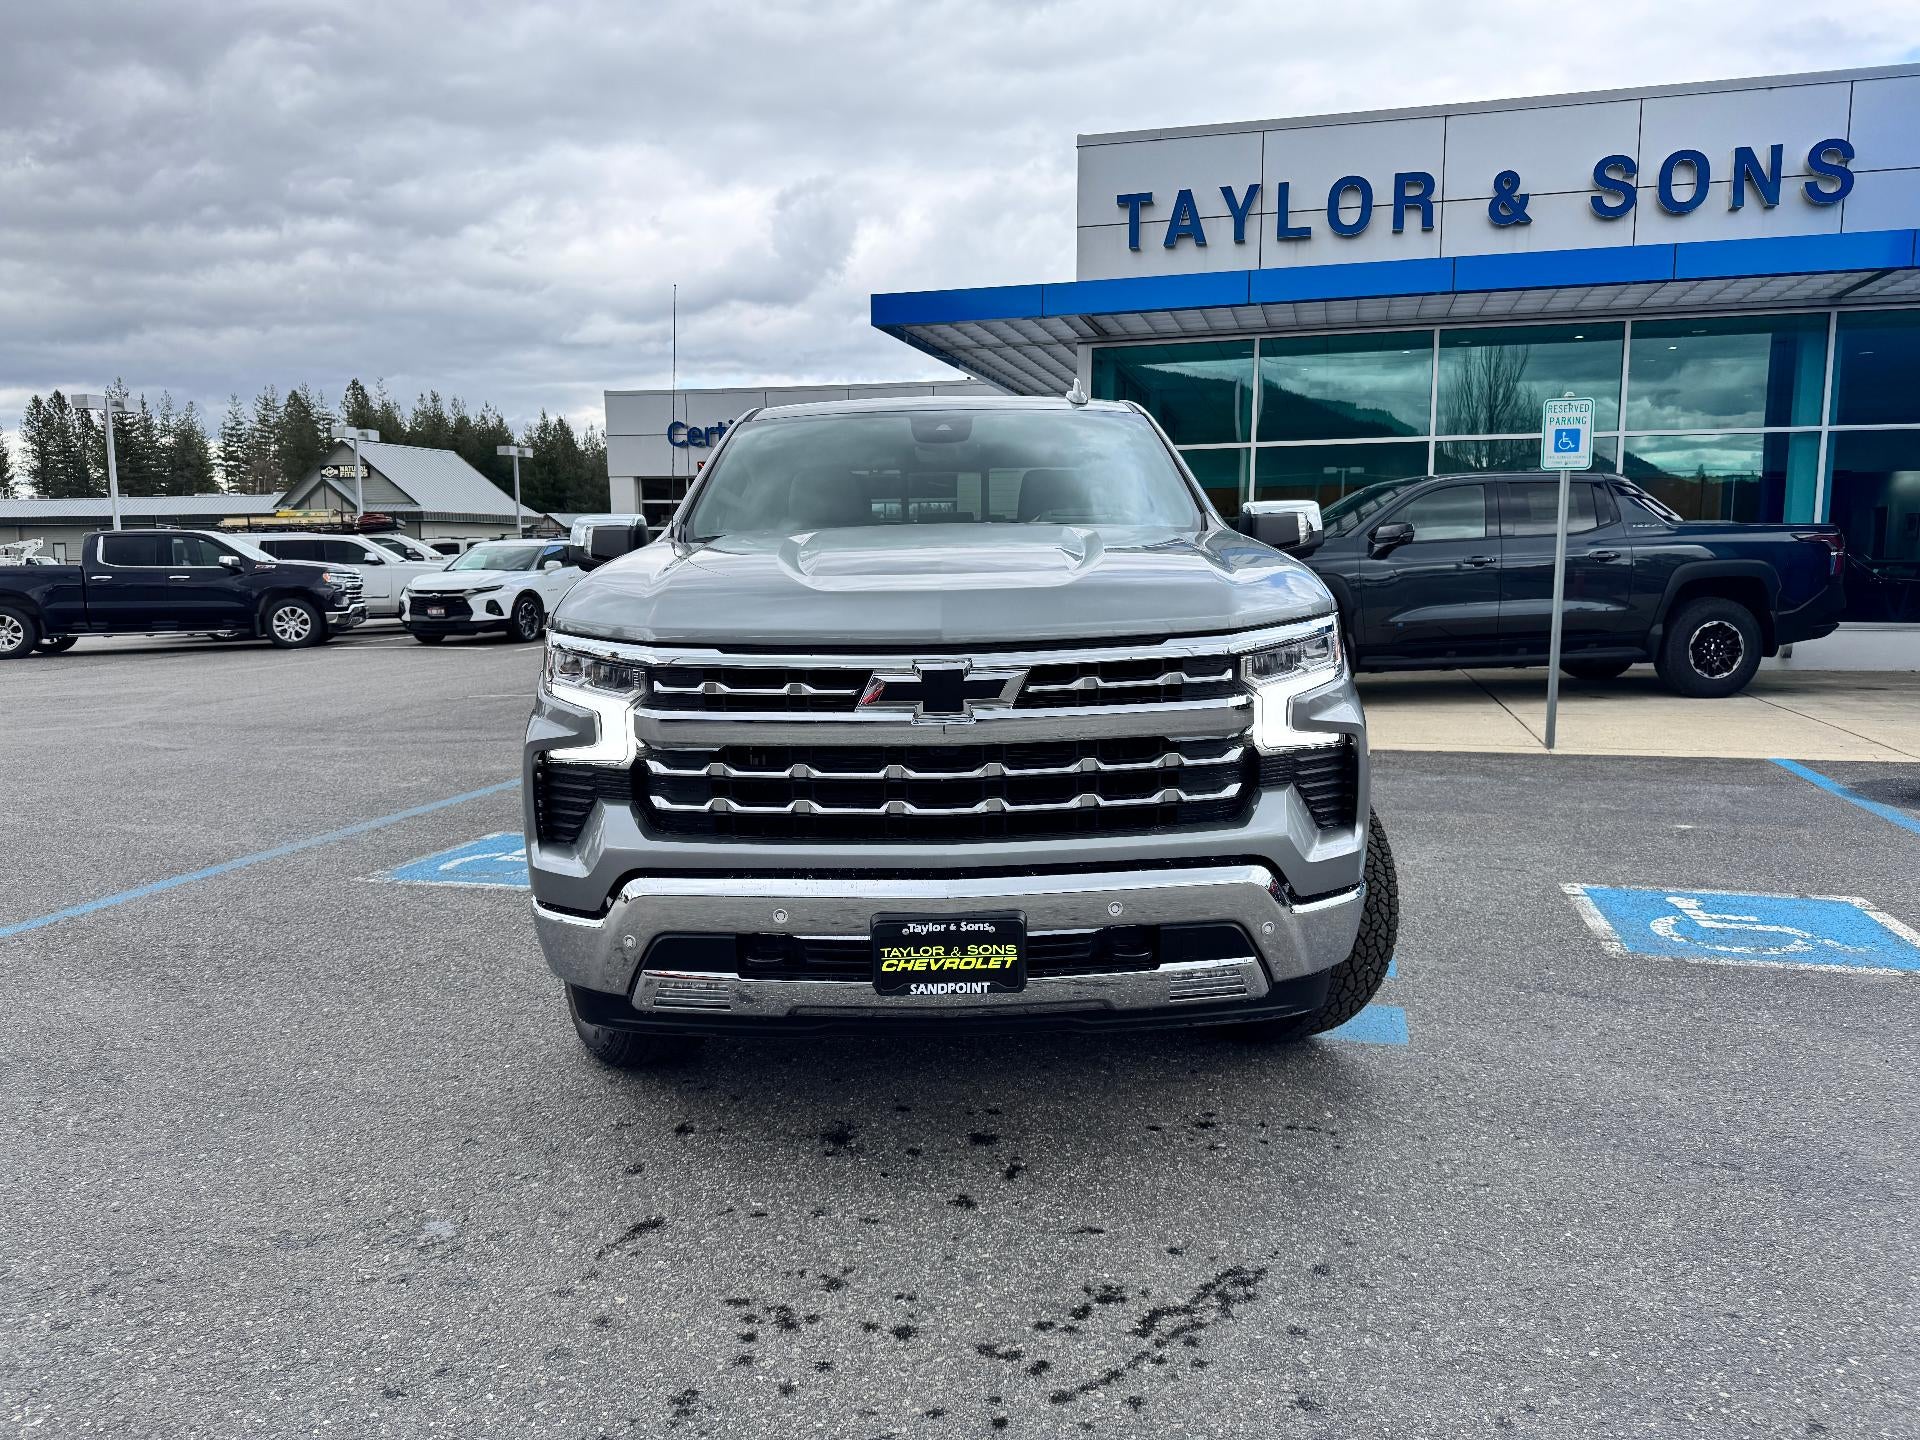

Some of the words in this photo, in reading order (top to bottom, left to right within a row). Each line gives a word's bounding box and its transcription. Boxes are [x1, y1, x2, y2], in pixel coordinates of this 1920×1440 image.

[1117, 171, 1435, 250] TAYLOR
[1488, 170, 1532, 226] &
[1591, 138, 1855, 220] SONS
[1548, 403, 1590, 413] RESERVED
[1550, 416, 1587, 425] PARKING
[667, 419, 736, 448] Cert
[907, 923, 946, 935] Taylor
[949, 923, 957, 931] &
[960, 921, 990, 932] Sons
[880, 946, 945, 957] TAYLOR
[950, 946, 961, 957] &
[967, 944, 1017, 955] SONS
[881, 957, 1018, 971] CHEVROLET
[910, 982, 991, 995] SANDPOINT
